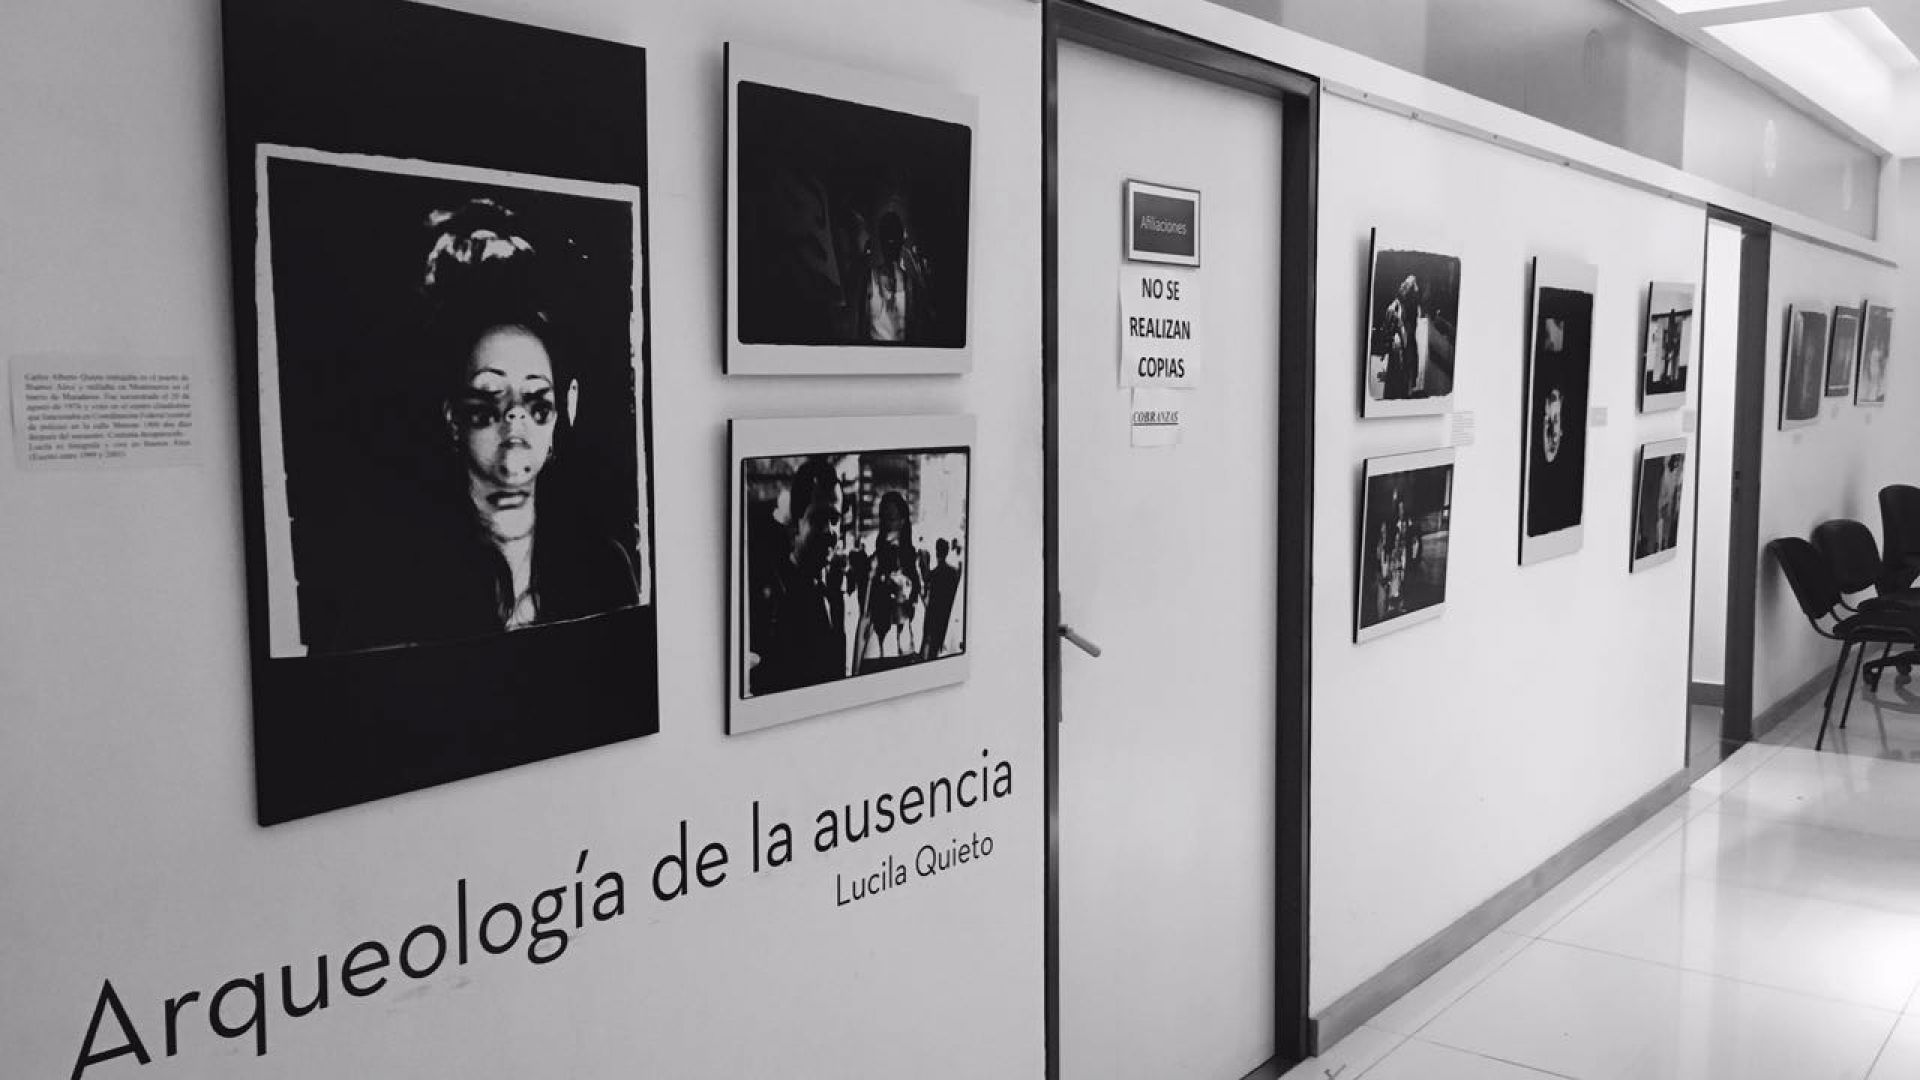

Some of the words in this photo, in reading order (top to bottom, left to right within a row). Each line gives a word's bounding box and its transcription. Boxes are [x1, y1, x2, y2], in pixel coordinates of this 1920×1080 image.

[1140, 215, 1187, 236] Afiliaciones
[1142, 277, 1163, 300] NO
[1166, 280, 1180, 301] SE
[1129, 316, 1191, 340] REALIZAN
[1138, 357, 1185, 378] COPIAS
[1132, 410, 1179, 425] COBRANZAS
[836, 855, 907, 907] Lucila
[915, 832, 994, 877] Quieto
[70, 849, 626, 1080] Arqueología
[652, 820, 729, 902] de
[752, 800, 793, 873] la
[814, 748, 1013, 853] ausencia
